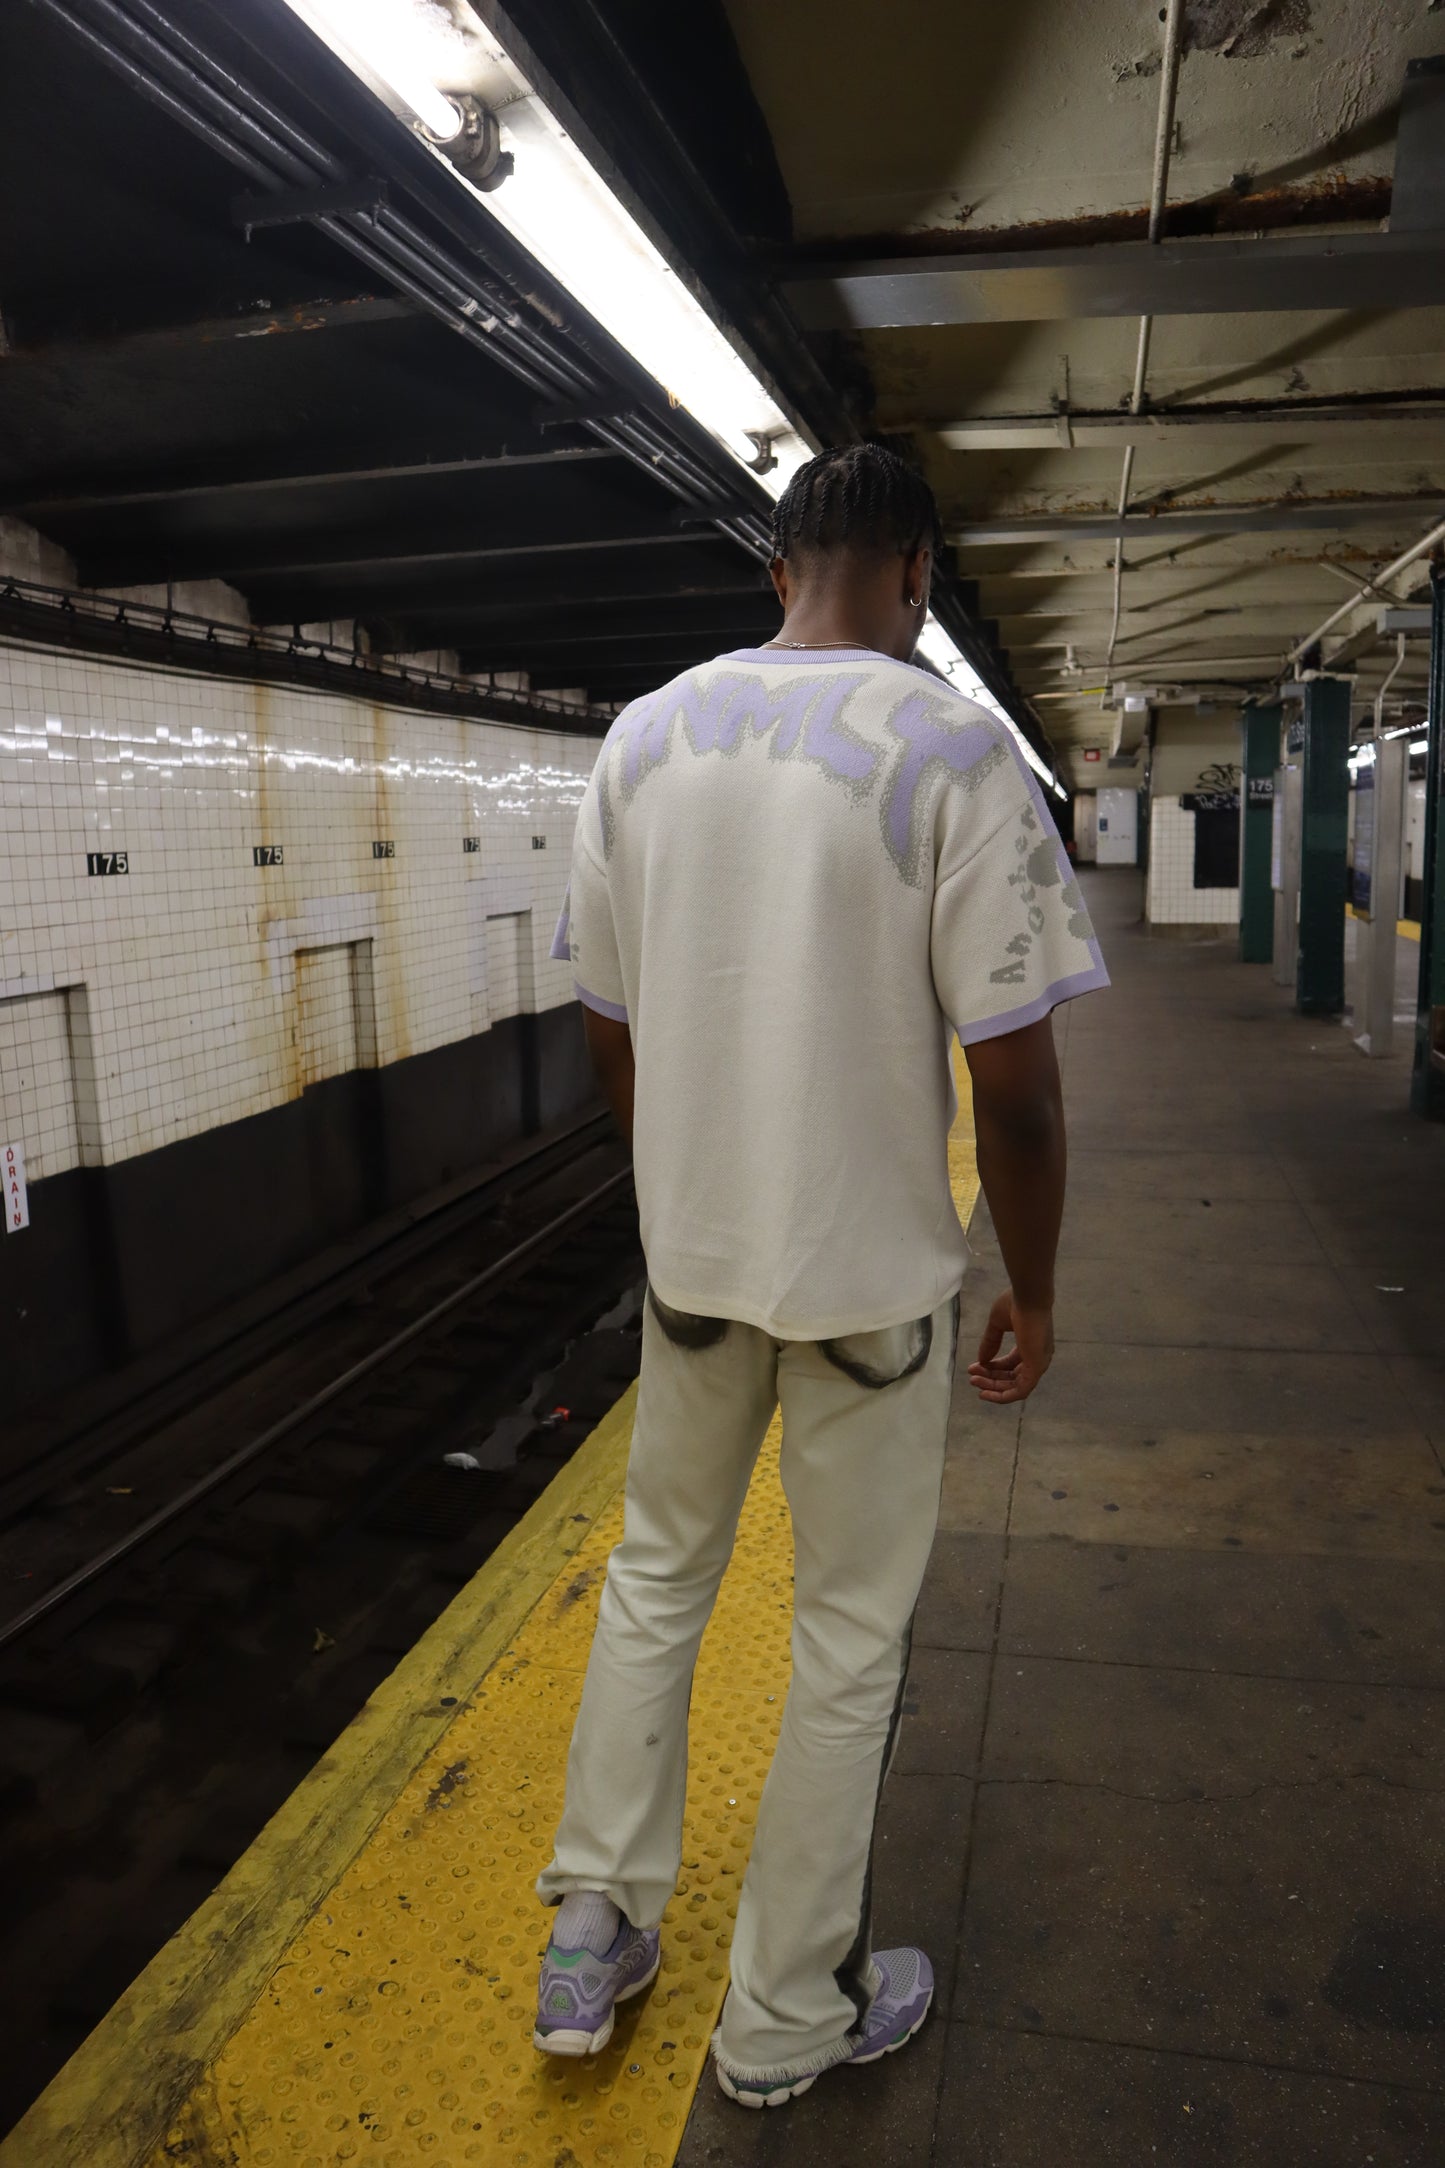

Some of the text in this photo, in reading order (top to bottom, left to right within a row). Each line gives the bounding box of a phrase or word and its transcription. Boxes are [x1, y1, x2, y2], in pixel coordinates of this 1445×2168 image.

[1250, 780, 1273, 792] 175
[374, 842, 394, 858] 175
[464, 838, 481, 852] 175
[91, 853, 128, 874] 175
[256, 846, 283, 865] 175
[6, 1149, 22, 1226] DRAIN
